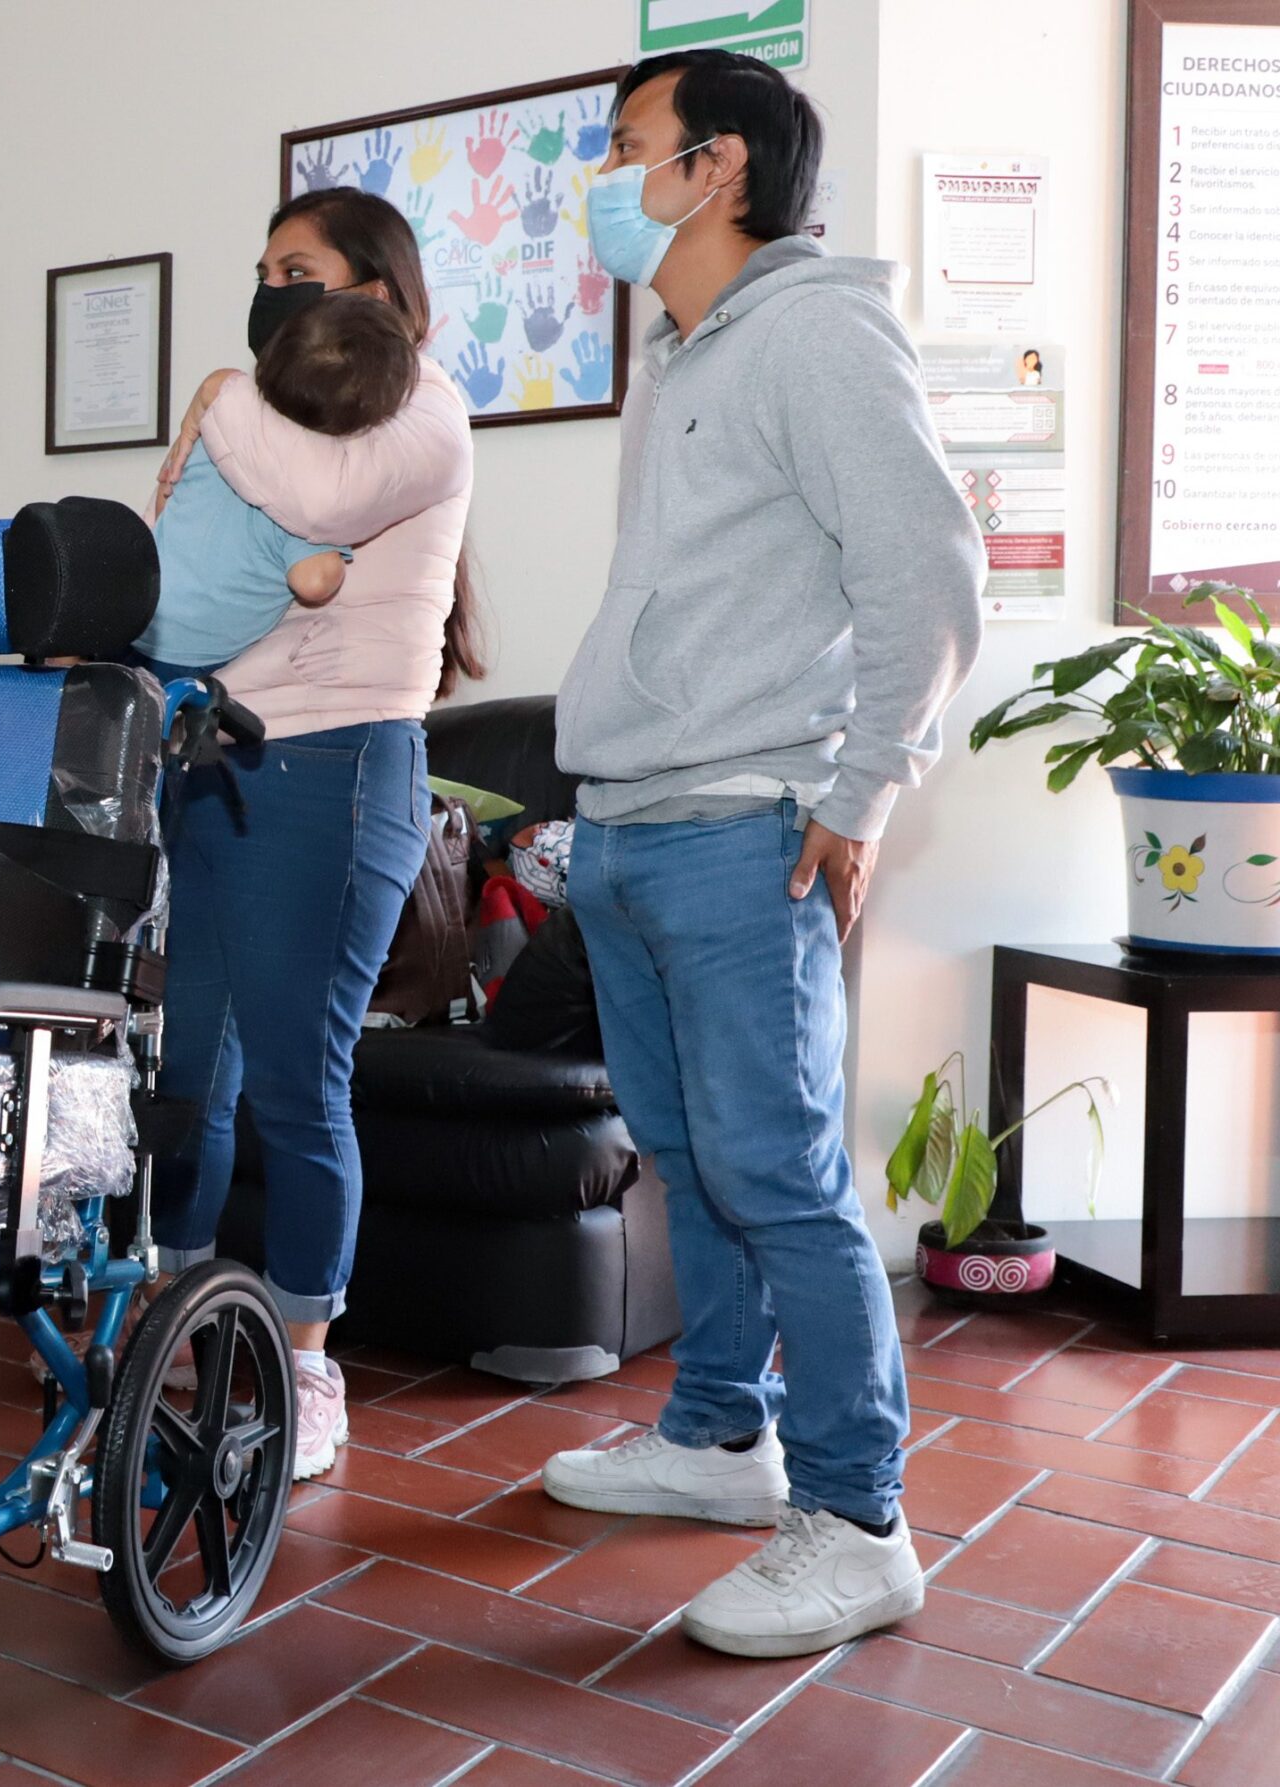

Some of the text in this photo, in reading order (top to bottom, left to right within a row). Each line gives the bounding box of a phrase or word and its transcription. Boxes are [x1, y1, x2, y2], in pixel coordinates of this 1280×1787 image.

[734, 38, 799, 61] UACIÓN
[1172, 125, 1181, 146] 1
[1191, 126, 1227, 137] Recibir
[1229, 129, 1243, 137] un
[1245, 127, 1270, 138] trato
[1191, 140, 1255, 151] preferencias
[1169, 162, 1280, 183] 2 Recibir el servicio
[1169, 195, 1182, 217] 3
[1190, 204, 1207, 214] Ser
[1209, 205, 1262, 215] informado
[1166, 222, 1181, 243] 4
[1189, 230, 1232, 241] Conocer
[1235, 231, 1244, 241] la
[521, 240, 555, 261] DIF
[1167, 250, 1180, 272] 5
[1188, 256, 1206, 266] Ser
[1208, 257, 1261, 267] informado
[1166, 284, 1179, 305] 6
[1188, 282, 1201, 292] En
[1203, 284, 1228, 292] caso
[1230, 283, 1242, 292] de
[1188, 296, 1238, 306] orientado
[1240, 296, 1253, 306] de
[1165, 324, 1178, 345] 7
[1188, 321, 1197, 331] Si
[1199, 322, 1208, 331] el
[1211, 322, 1252, 331] servidor
[1187, 335, 1204, 345] por
[1206, 335, 1216, 344] el
[1163, 384, 1178, 405] 8
[1185, 385, 1226, 395] Adultos
[1228, 387, 1272, 398] mayores
[1185, 400, 1232, 410] personas
[1234, 401, 1254, 409] con
[1184, 412, 1198, 421] de
[1161, 444, 1175, 465] 9
[1154, 479, 1176, 499] 10
[1183, 488, 1237, 498] Garantizar
[1162, 519, 1277, 532] Gobierno cercano
